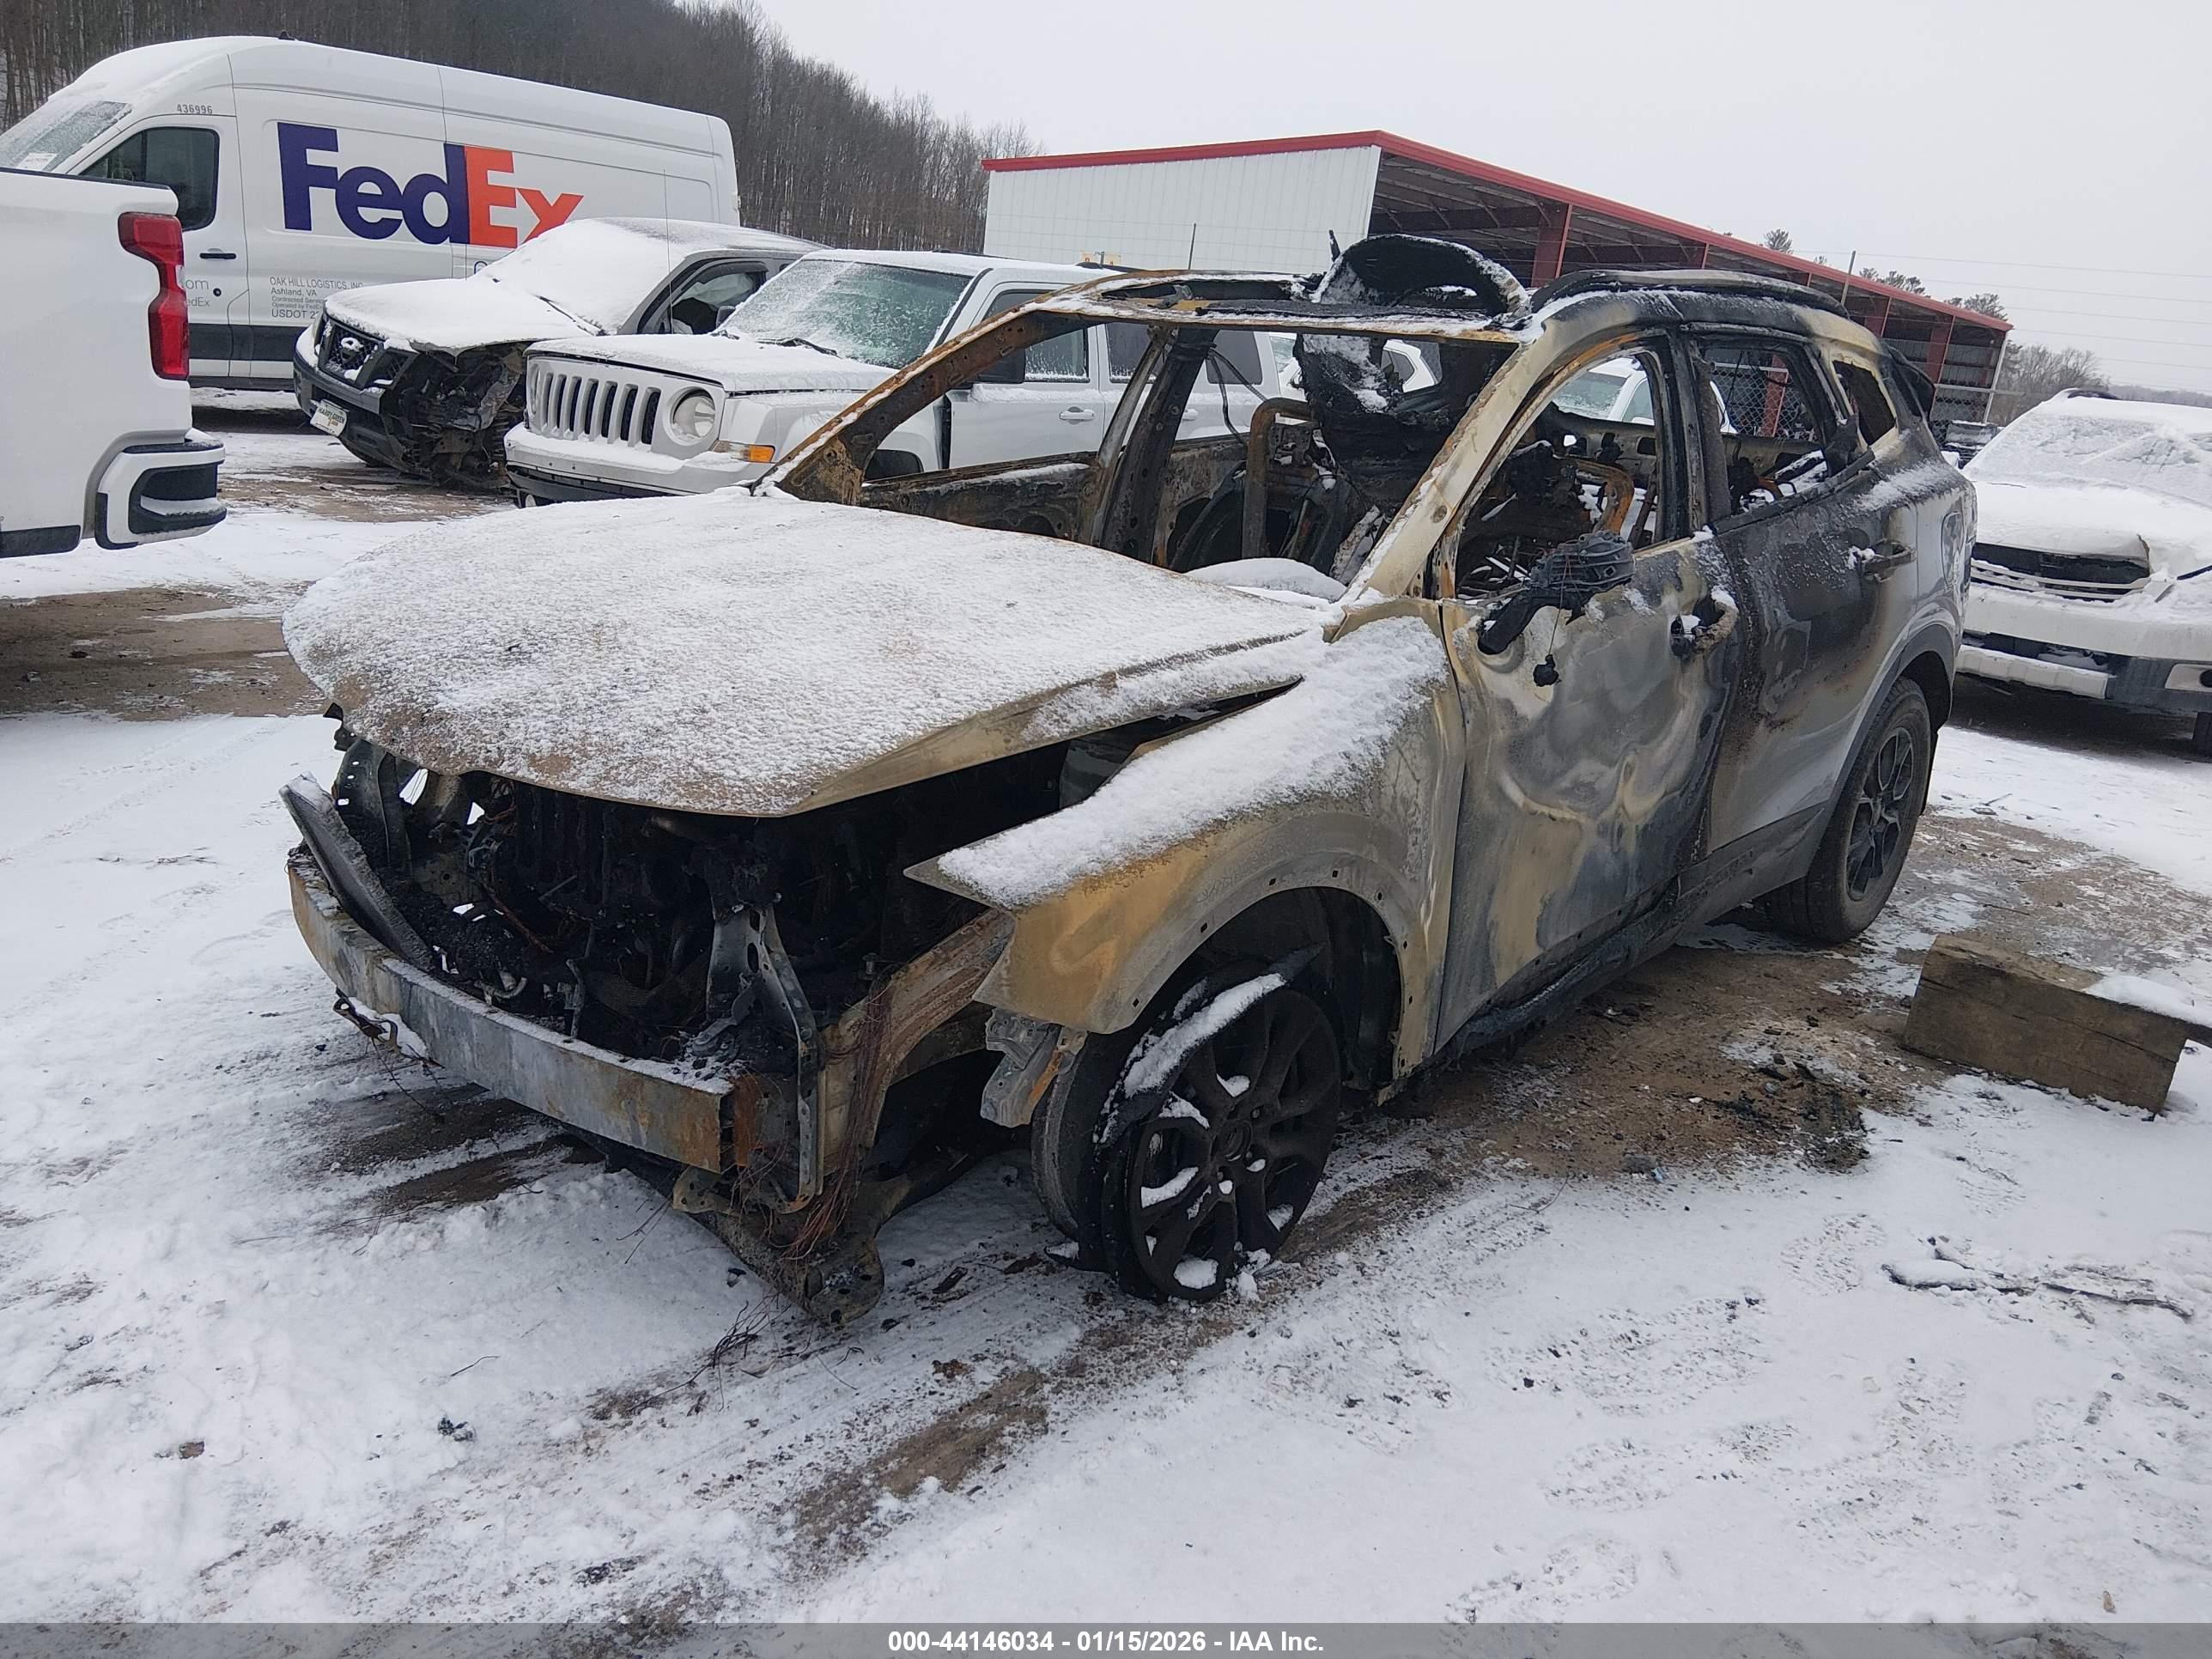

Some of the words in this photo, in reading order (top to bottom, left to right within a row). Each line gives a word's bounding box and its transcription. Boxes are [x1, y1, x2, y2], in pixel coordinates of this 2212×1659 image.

[177, 104, 213, 114] 436996
[277, 122, 584, 249] FedEx
[270, 276, 286, 286] OAK
[288, 278, 305, 288] HILL
[271, 287, 305, 296] Ashland,
[186, 296, 210, 307] edEx
[271, 309, 307, 319] USDOT
